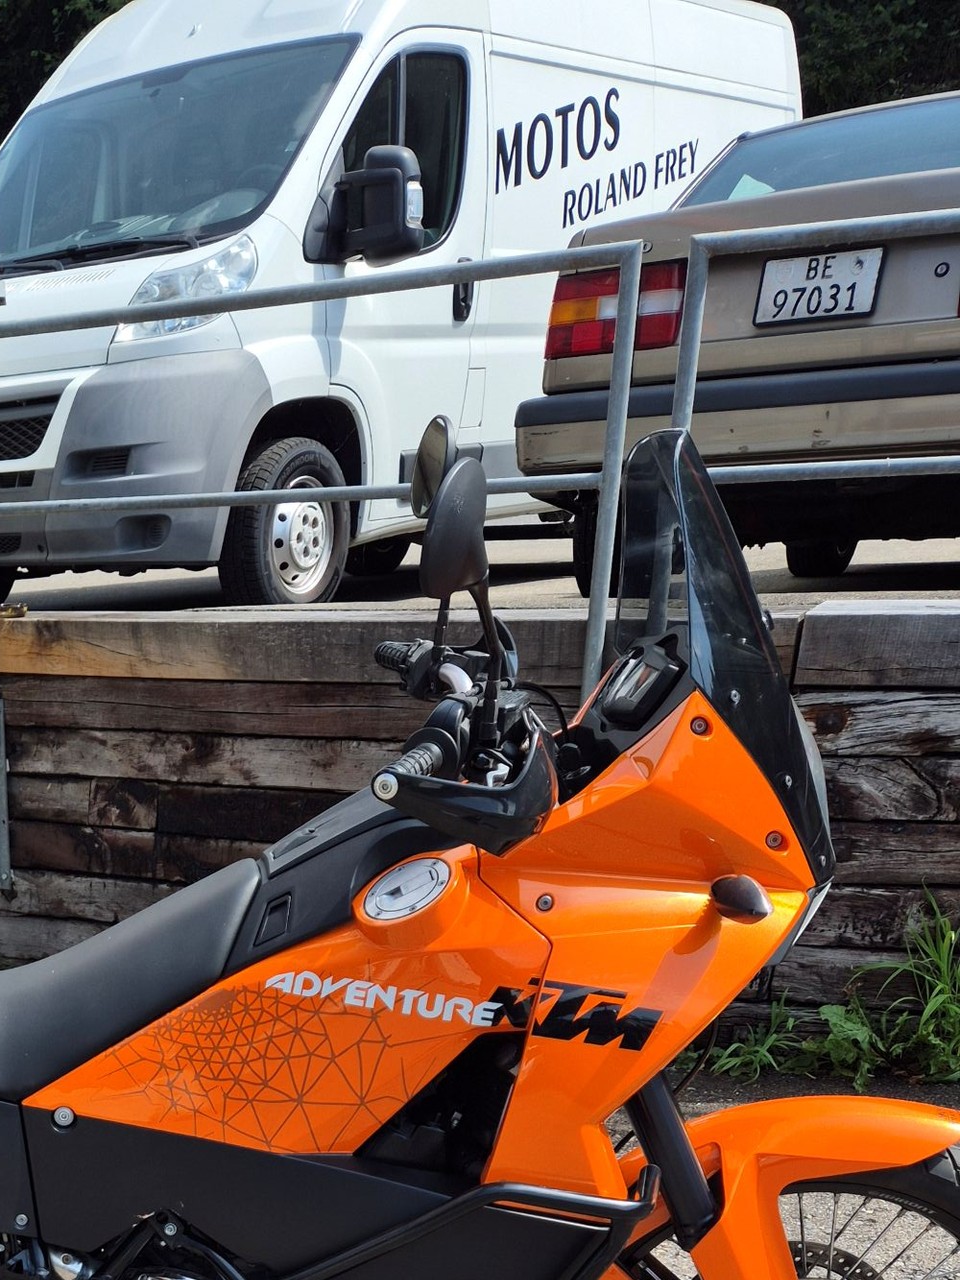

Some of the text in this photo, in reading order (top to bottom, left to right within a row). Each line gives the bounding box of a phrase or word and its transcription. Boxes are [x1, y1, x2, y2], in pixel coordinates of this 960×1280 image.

[495, 87, 620, 195] MOTOS
[562, 138, 699, 229] ROLAND FREY
[772, 282, 857, 319] 97031
[805, 255, 837, 281] BE
[265, 970, 504, 1027] ADVENTURE
[489, 977, 664, 1052] KTM
